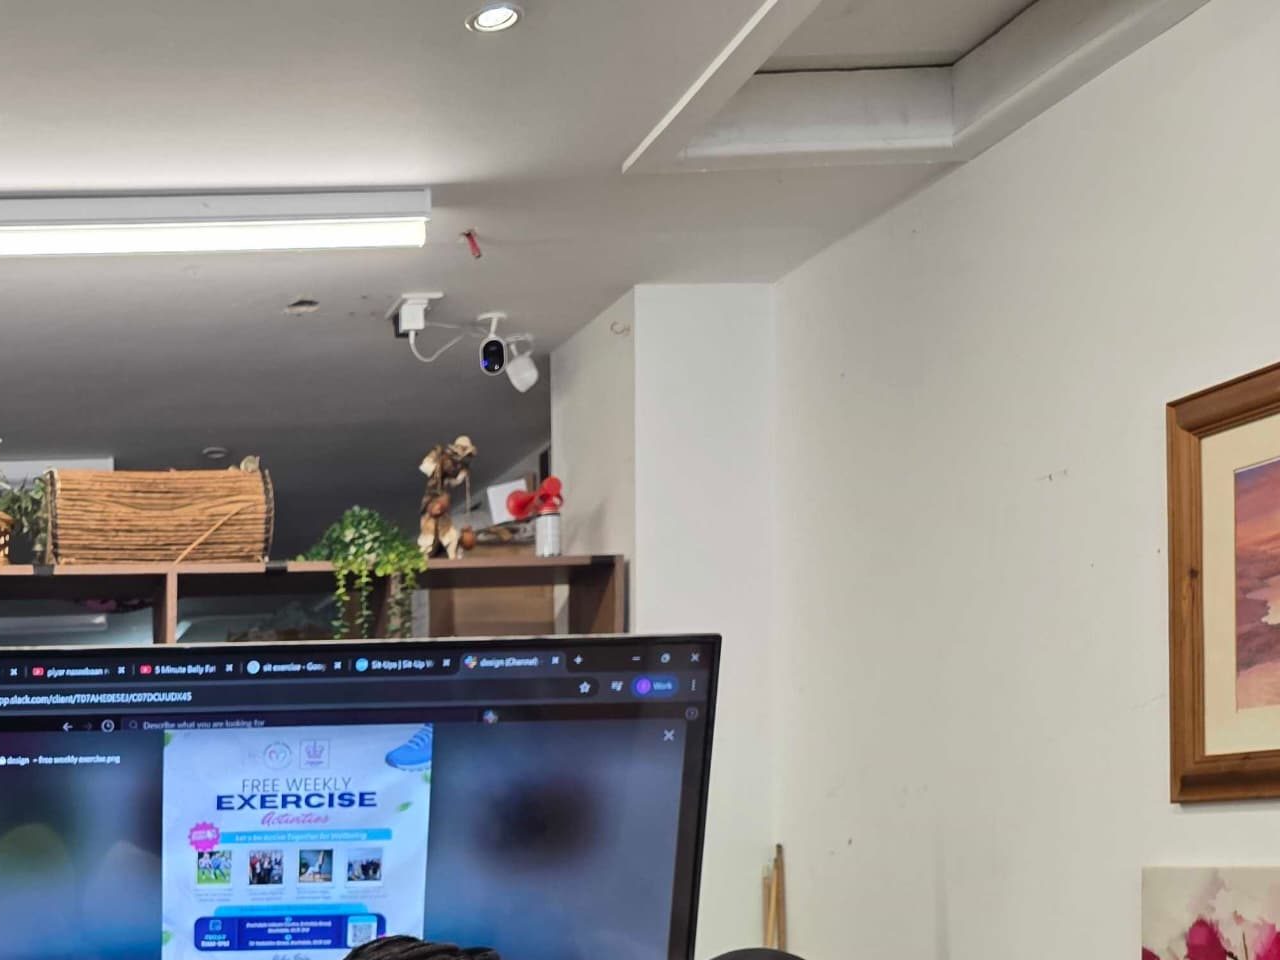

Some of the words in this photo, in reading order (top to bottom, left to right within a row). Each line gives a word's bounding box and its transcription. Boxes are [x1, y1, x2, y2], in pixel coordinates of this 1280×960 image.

[177, 720, 195, 729] what
[197, 721, 211, 730] you
[225, 719, 252, 729] looking
[254, 718, 265, 727] for
[241, 778, 280, 793] FREE
[286, 776, 353, 792] WEEKLY
[216, 791, 378, 811] EXERCISE
